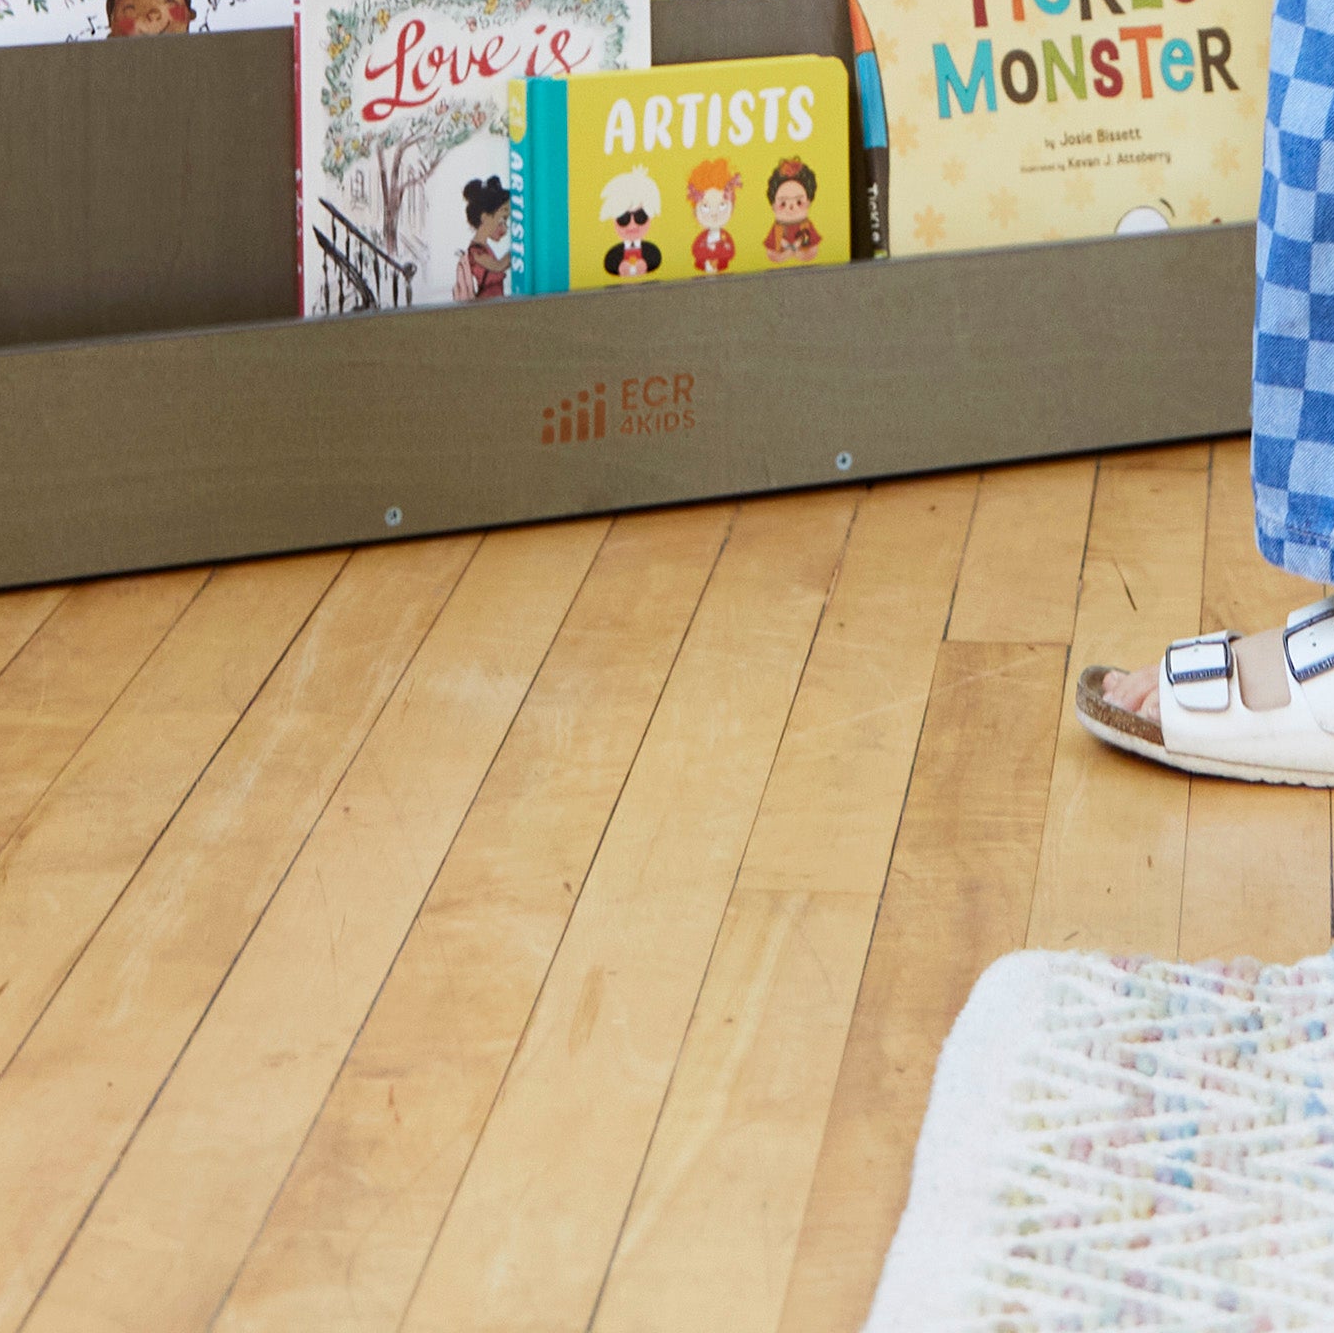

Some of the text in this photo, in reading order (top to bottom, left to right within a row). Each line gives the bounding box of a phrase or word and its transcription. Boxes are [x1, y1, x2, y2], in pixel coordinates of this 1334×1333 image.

[362, 18, 520, 124] Love
[527, 24, 592, 76] is
[603, 84, 816, 156] ARTISTS
[1060, 131, 1092, 146] Josie
[1097, 128, 1142, 143] Bissett
[511, 151, 525, 273] ARTISTS
[621, 372, 695, 411] ECR
[620, 409, 696, 434] 4KIDS
